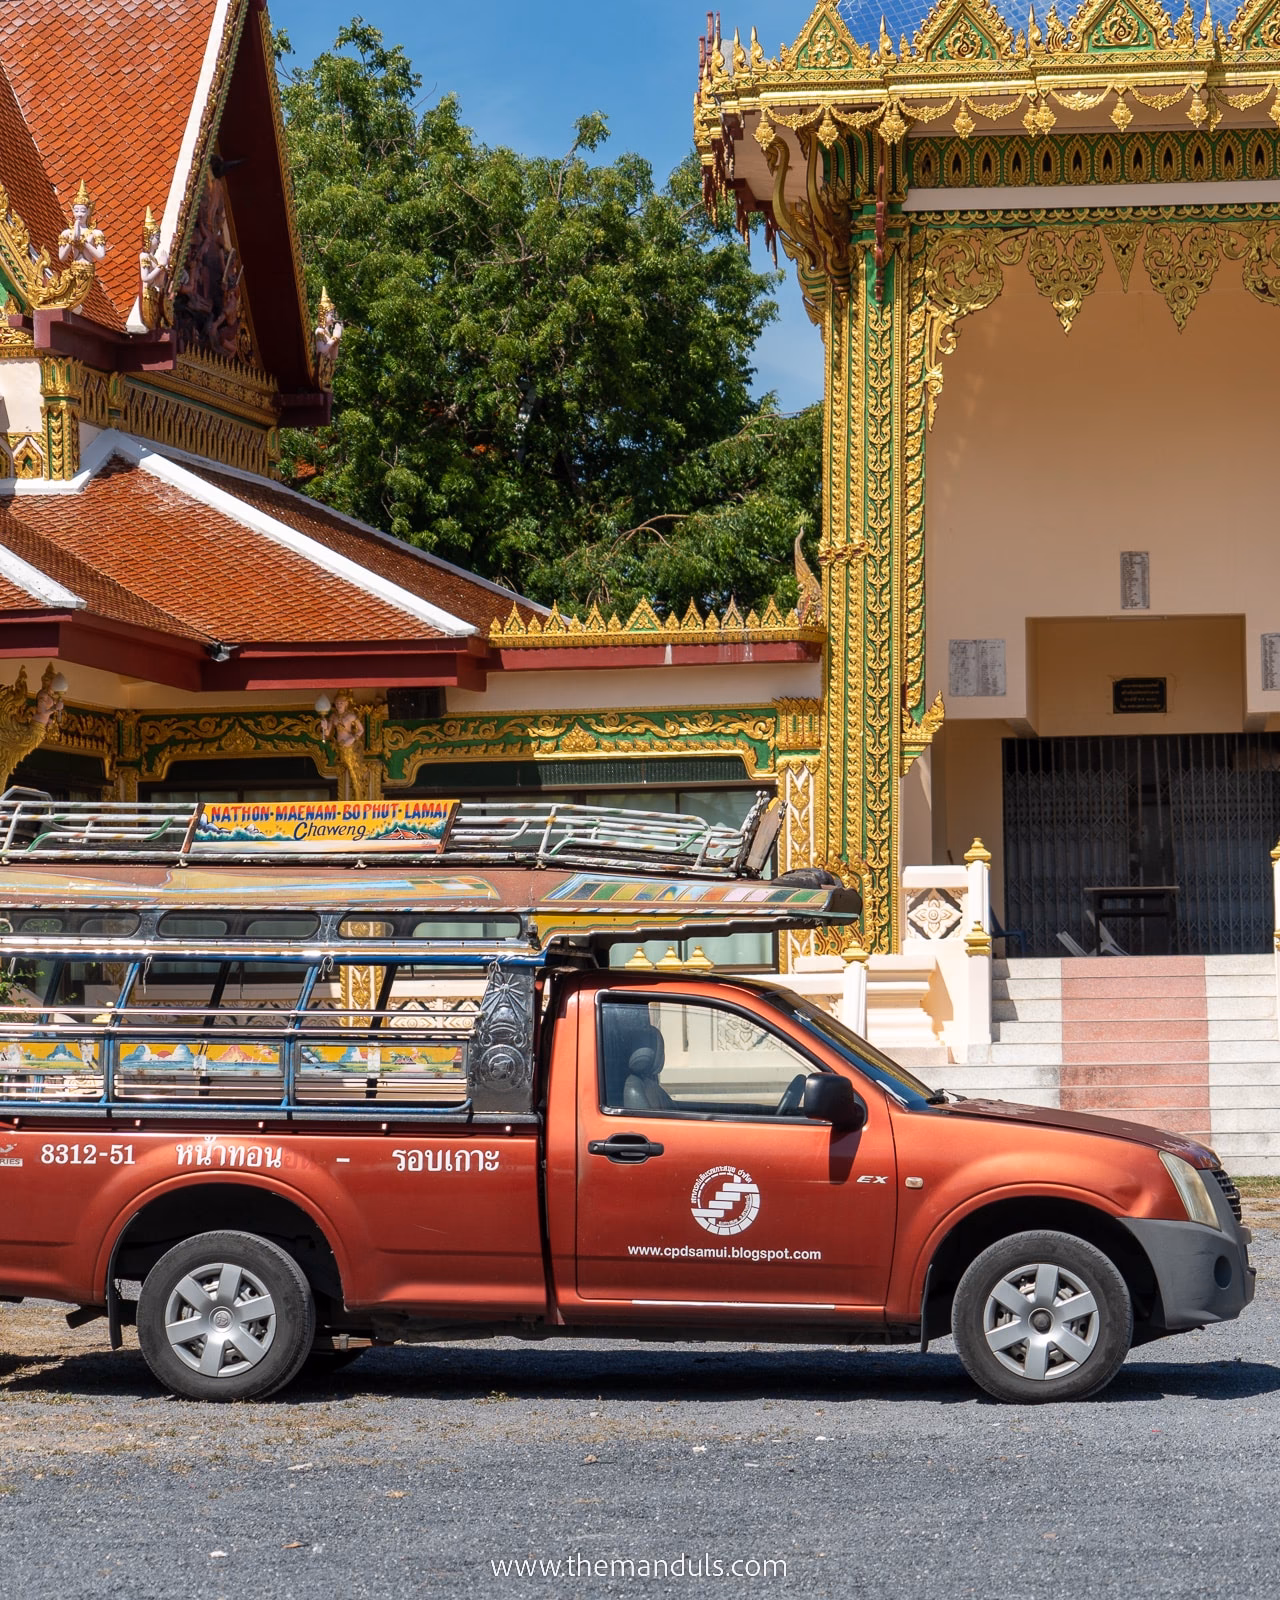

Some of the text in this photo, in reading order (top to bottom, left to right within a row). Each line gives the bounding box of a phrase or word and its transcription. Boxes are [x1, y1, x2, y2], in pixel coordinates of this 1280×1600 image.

[211, 806, 270, 822] NATHON
[275, 805, 337, 821] MAENAM
[404, 802, 448, 819] LAMAI
[293, 821, 367, 842] Chaweng
[40, 1143, 136, 1165] 8312-51
[175, 1135, 282, 1168] หน้าทอน
[392, 1149, 500, 1172] รอบเกาะ
[856, 1175, 889, 1184] EX
[627, 1245, 822, 1262] www.cpdsamui.blogspot.com
